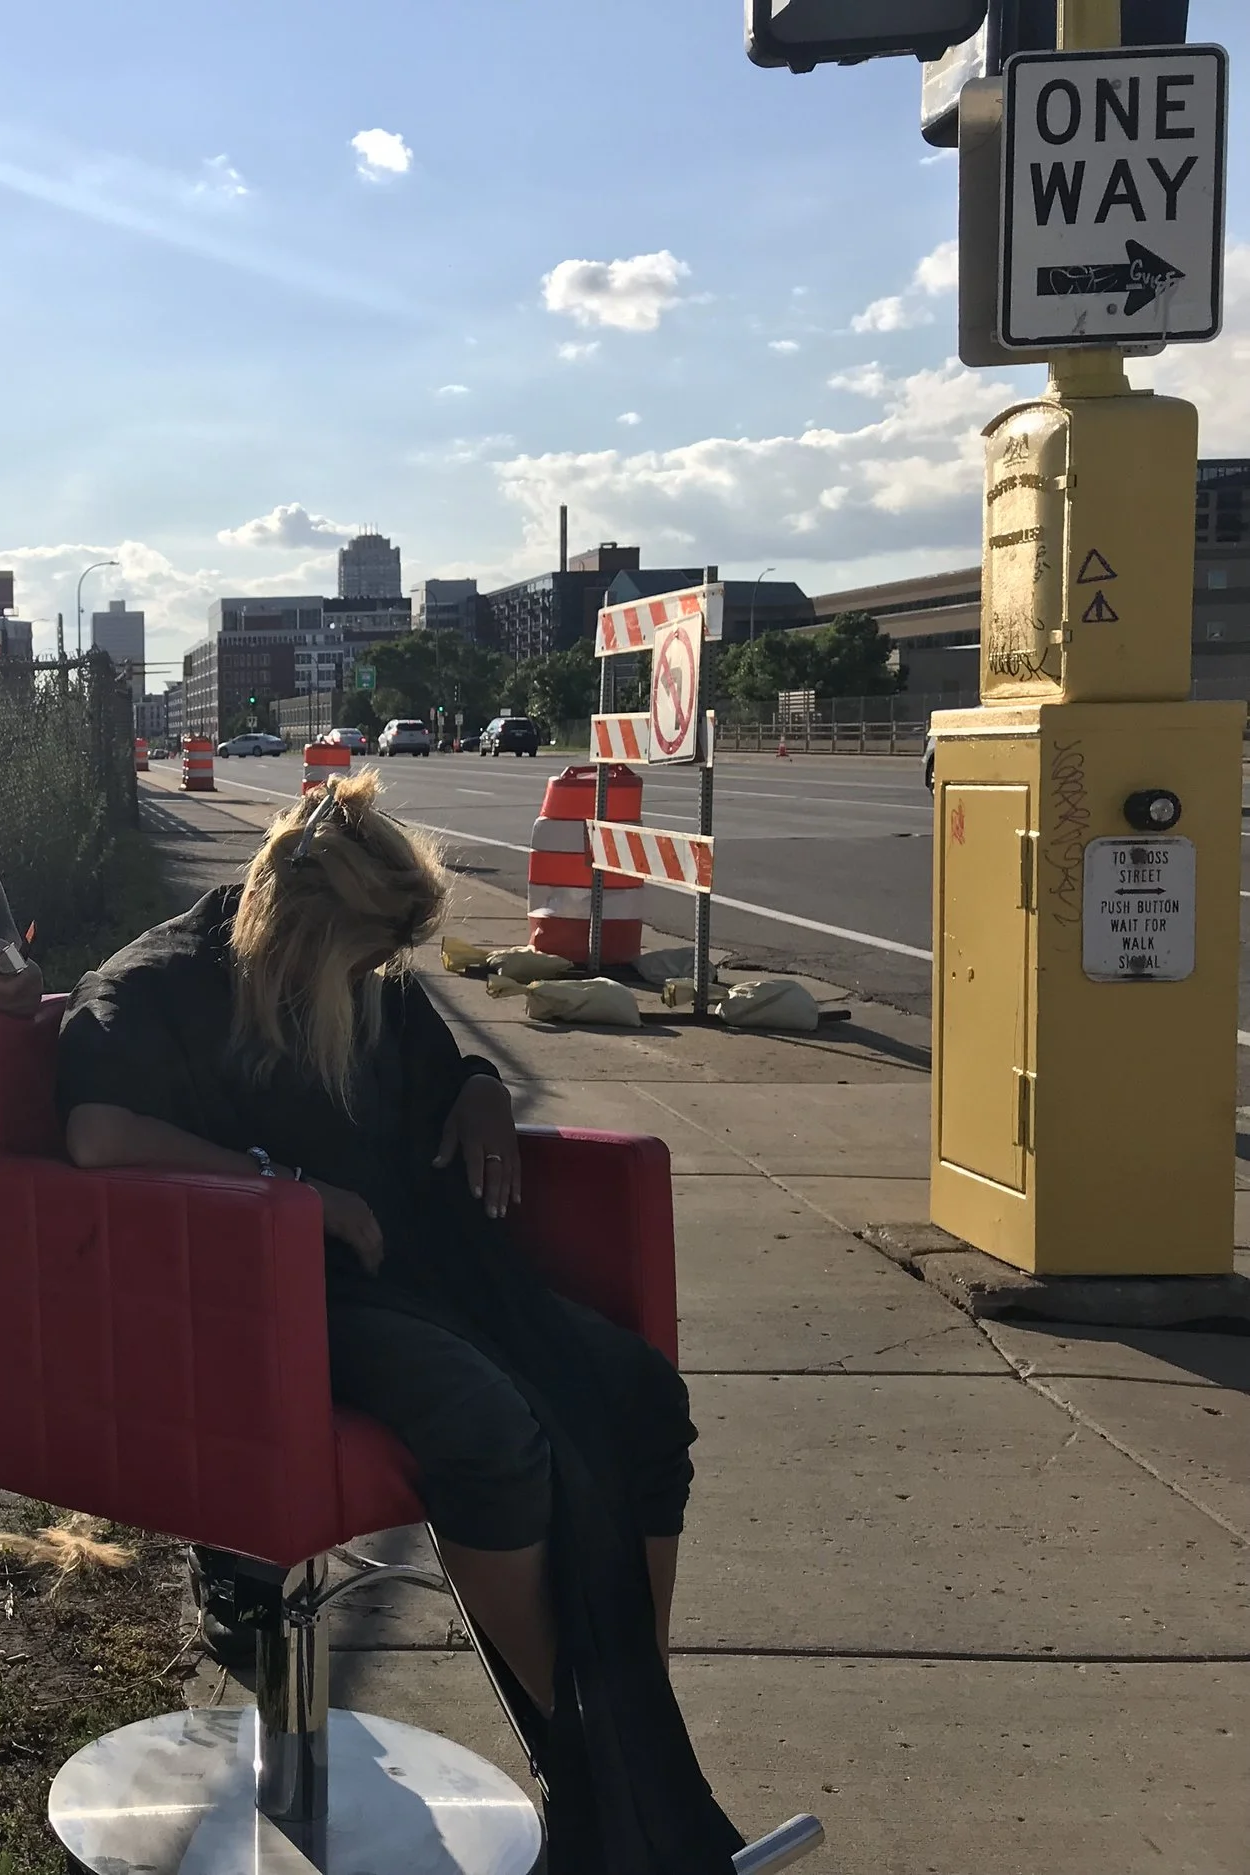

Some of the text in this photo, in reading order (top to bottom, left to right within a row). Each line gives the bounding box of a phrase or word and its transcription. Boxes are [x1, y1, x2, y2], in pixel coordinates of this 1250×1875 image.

[1036, 75, 1195, 145] ONE
[1030, 156, 1199, 226] WAY
[1113, 850, 1169, 865] TO OSS
[1119, 869, 1161, 883] STREET
[1101, 900, 1180, 914] PUSH BUTTON
[1110, 919, 1167, 932] WAIT FOR
[1122, 937, 1155, 950] WALK
